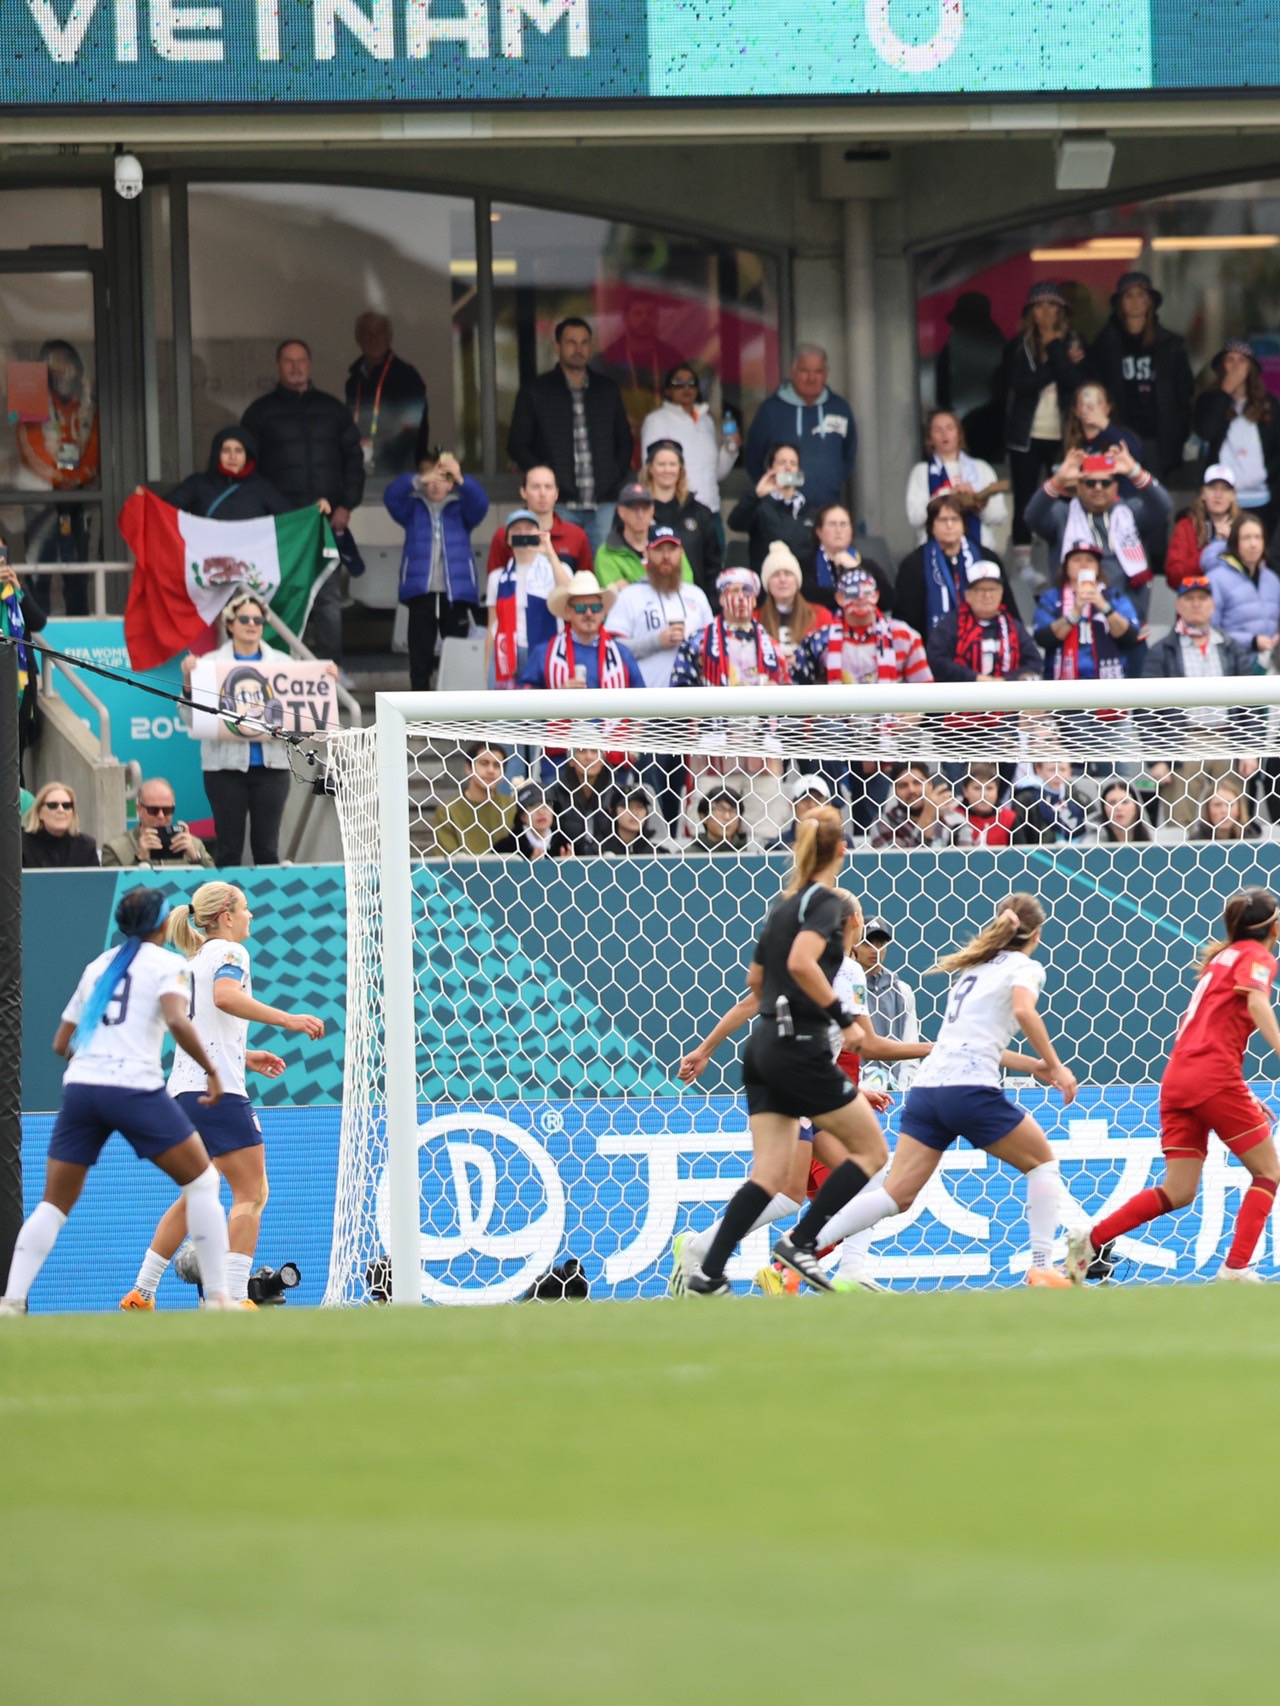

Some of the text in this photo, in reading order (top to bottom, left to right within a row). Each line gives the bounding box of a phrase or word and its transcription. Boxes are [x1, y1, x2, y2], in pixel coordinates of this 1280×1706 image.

[645, 609, 661, 632] 16
[273, 673, 329, 696] Cazé
[287, 701, 330, 732] TV
